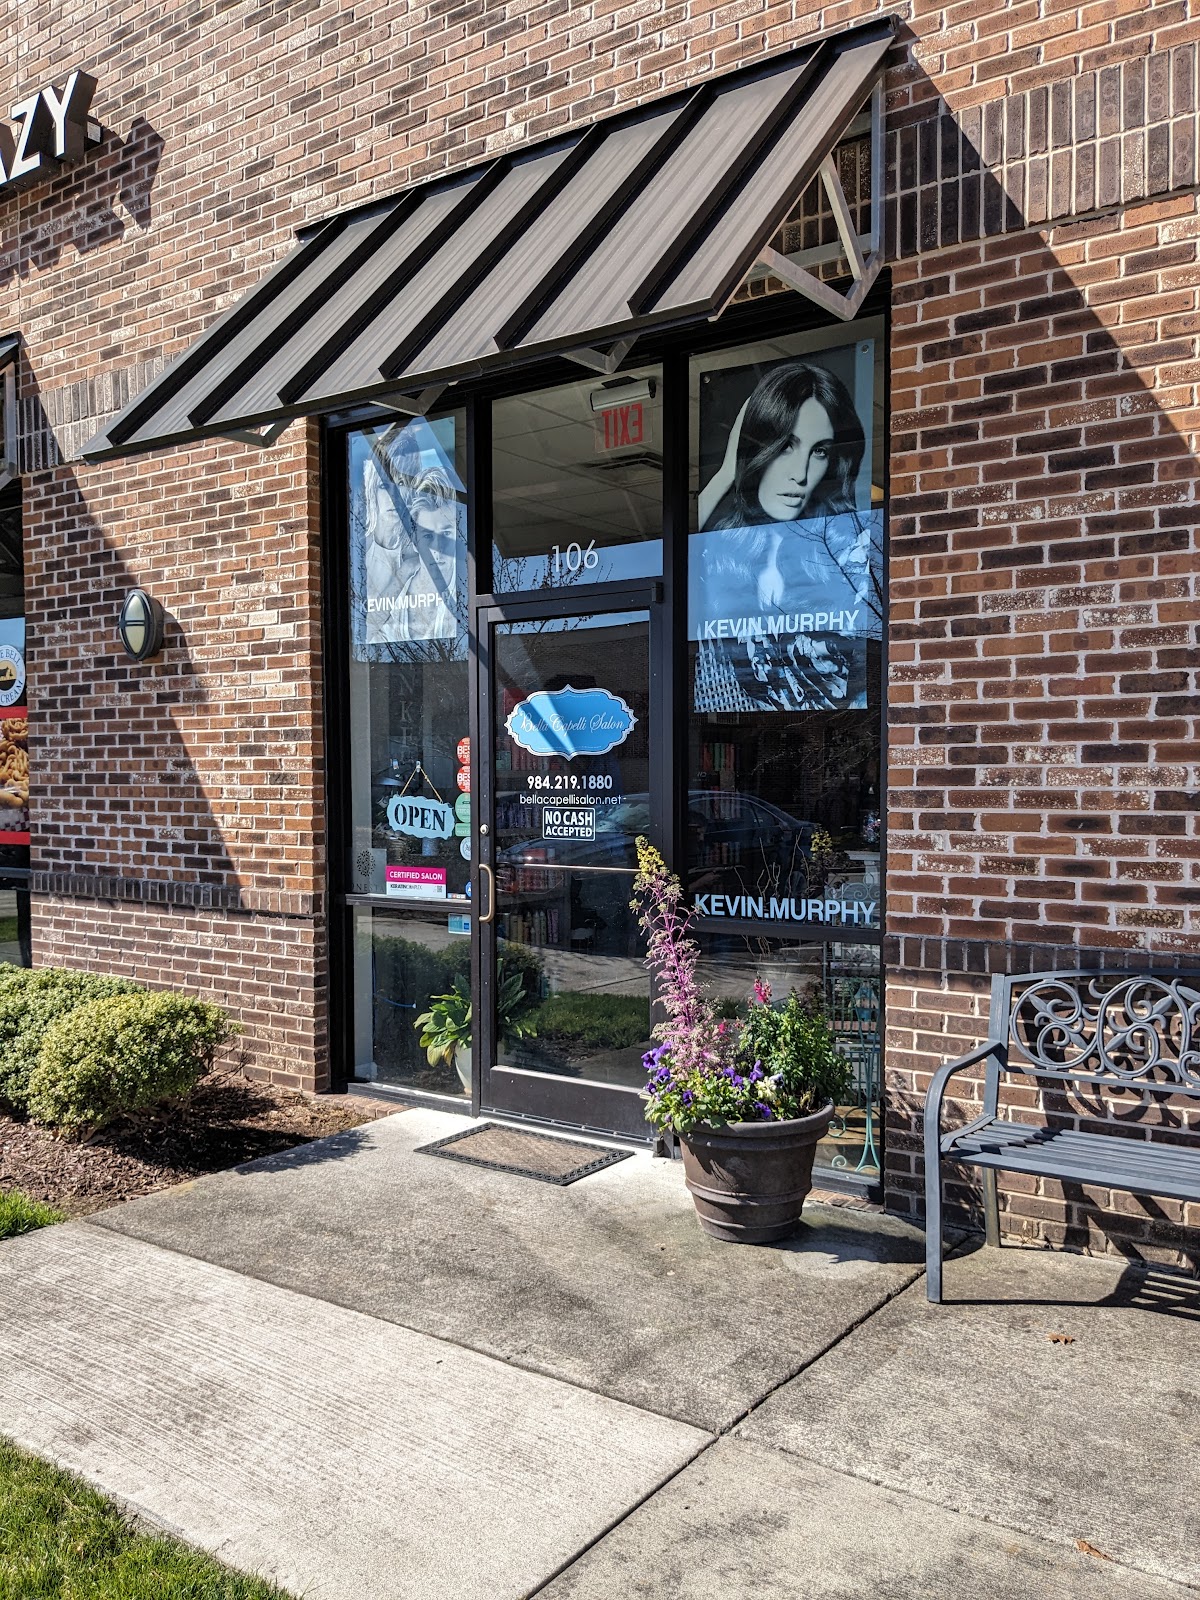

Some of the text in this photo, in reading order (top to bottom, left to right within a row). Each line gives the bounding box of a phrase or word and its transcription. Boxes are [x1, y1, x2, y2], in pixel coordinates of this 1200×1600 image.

[0, 70, 82, 185] ZY
[551, 539, 599, 573] 106
[704, 609, 860, 639] KEVIN.MURPHY
[550, 713, 586, 737] Capelli
[589, 711, 624, 733] Salon
[527, 775, 613, 790] 984.219.1880
[519, 794, 622, 807] bellacapellisalon.net
[394, 802, 447, 832] OPEN
[545, 810, 593, 826] NO CASH
[545, 825, 593, 838] ACCEPTED
[389, 870, 443, 881] CERTIFIED SALON
[695, 893, 876, 924] KEVIN.MURPHY
